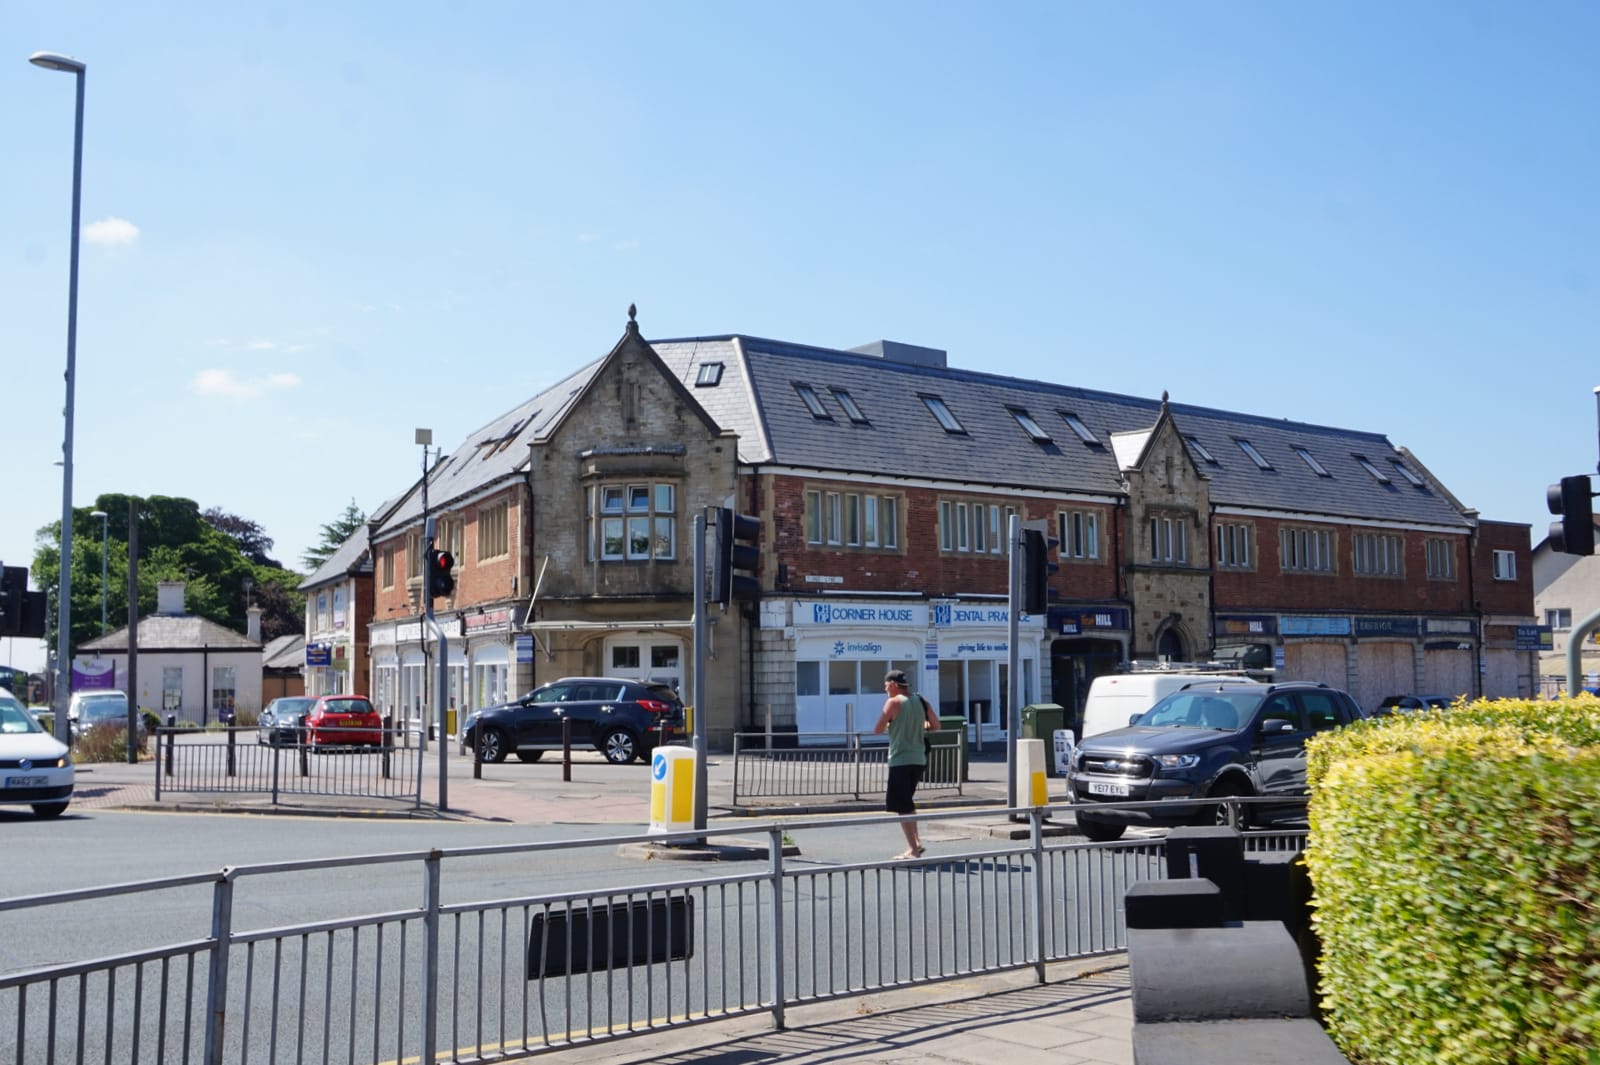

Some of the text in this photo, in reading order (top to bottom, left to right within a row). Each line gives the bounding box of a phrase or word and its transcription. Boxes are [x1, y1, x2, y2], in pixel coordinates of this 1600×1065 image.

[832, 608, 875, 620] CORNER
[879, 609, 912, 621] HOUSE
[1095, 613, 1112, 626] HILL
[1063, 623, 1077, 633] HILL
[847, 641, 882, 654] invisalign
